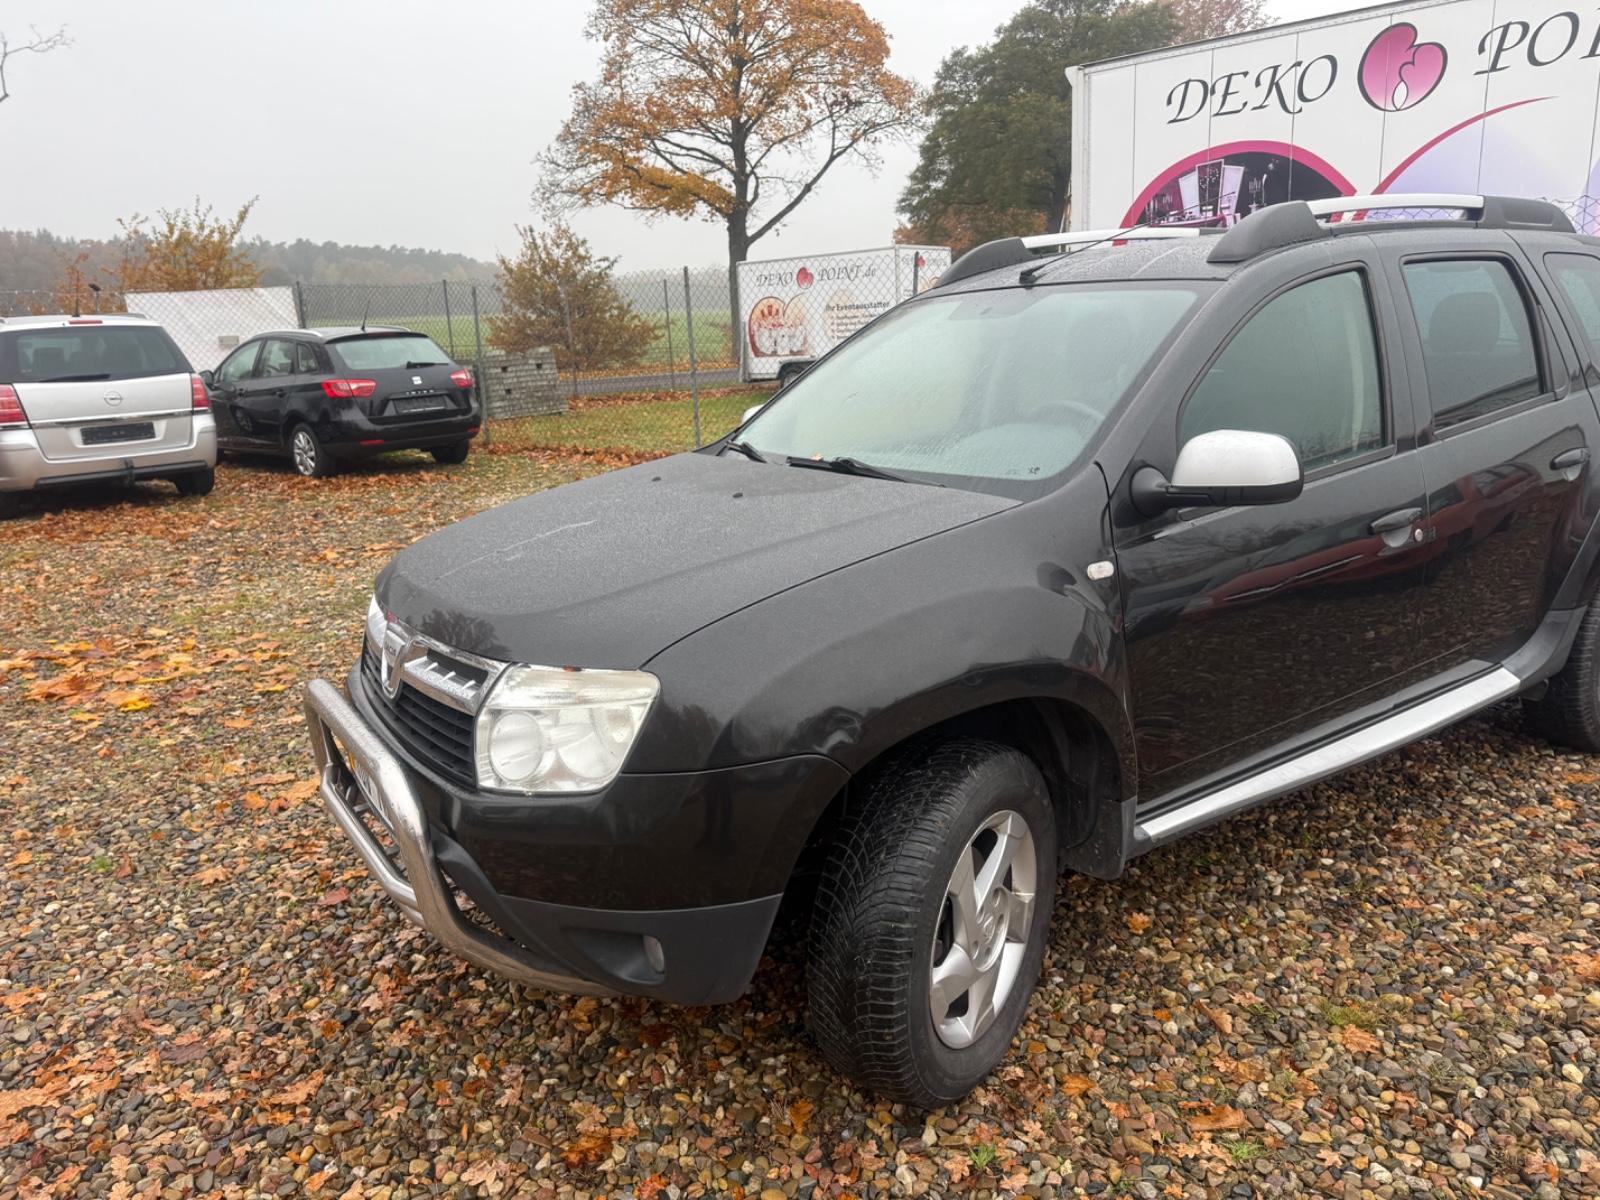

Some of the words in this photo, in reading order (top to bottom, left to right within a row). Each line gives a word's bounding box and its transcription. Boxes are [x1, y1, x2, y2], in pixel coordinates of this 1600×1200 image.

[1166, 54, 1338, 124] DEKO
[756, 272, 793, 288] DEKO
[818, 264, 877, 282] POINT.de
